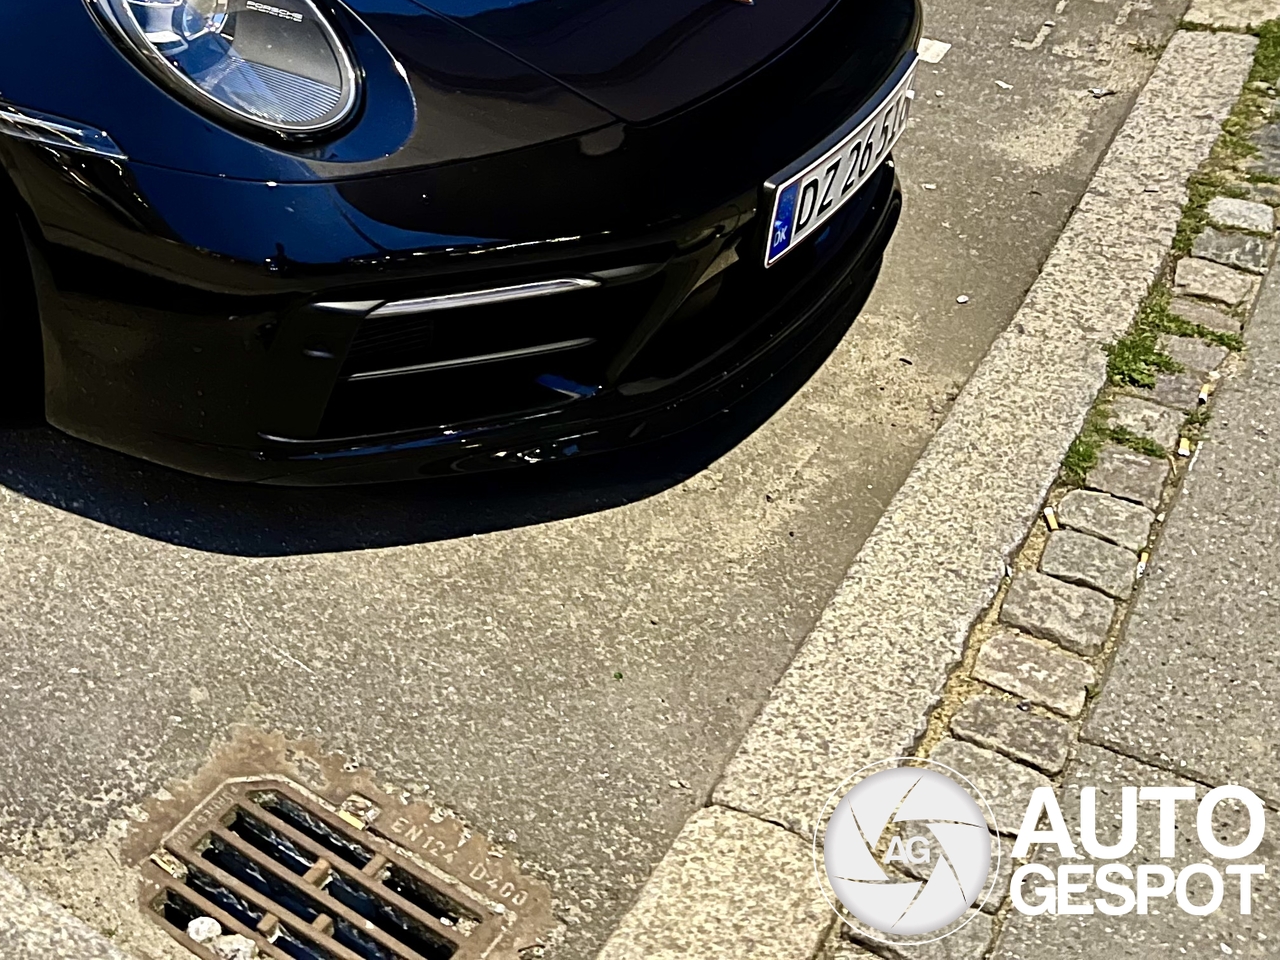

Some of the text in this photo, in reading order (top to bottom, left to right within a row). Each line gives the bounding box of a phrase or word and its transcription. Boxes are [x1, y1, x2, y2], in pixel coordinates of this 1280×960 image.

[246, 0, 304, 19] PORSCHE
[794, 155, 843, 236] DZ
[841, 121, 876, 197] 26
[773, 224, 788, 247] DK
